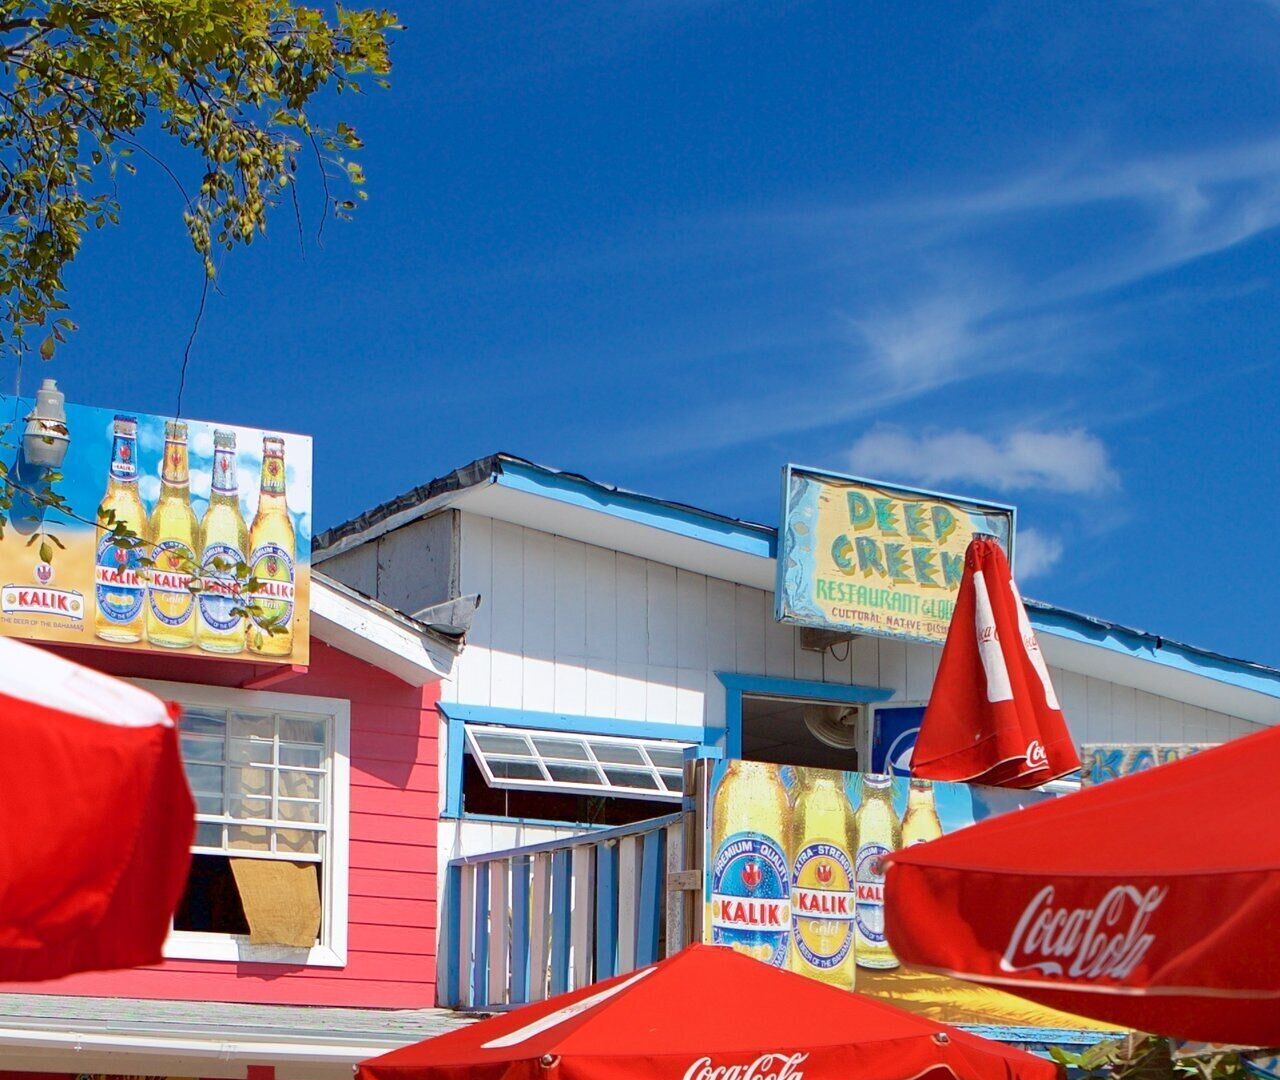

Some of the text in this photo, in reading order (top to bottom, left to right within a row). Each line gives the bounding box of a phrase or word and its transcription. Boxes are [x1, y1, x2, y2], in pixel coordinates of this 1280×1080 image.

[846, 490, 956, 545] DEEP
[831, 534, 963, 591] CREEK
[18, 591, 70, 612] KALIK
[257, 582, 289, 598] ALIK
[816, 578, 920, 615] RESTAURANT
[13, 618, 31, 626] BEER
[40, 620, 52, 628] THE
[832, 606, 881, 625] CULTURAL
[886, 613, 920, 631] NATIVE
[714, 840, 789, 884] PREMIUM QUALITY
[793, 845, 854, 882] EXTRA STRENGTH
[721, 899, 781, 926] KALIK
[799, 892, 848, 915] KALIK
[808, 920, 840, 936] Gold
